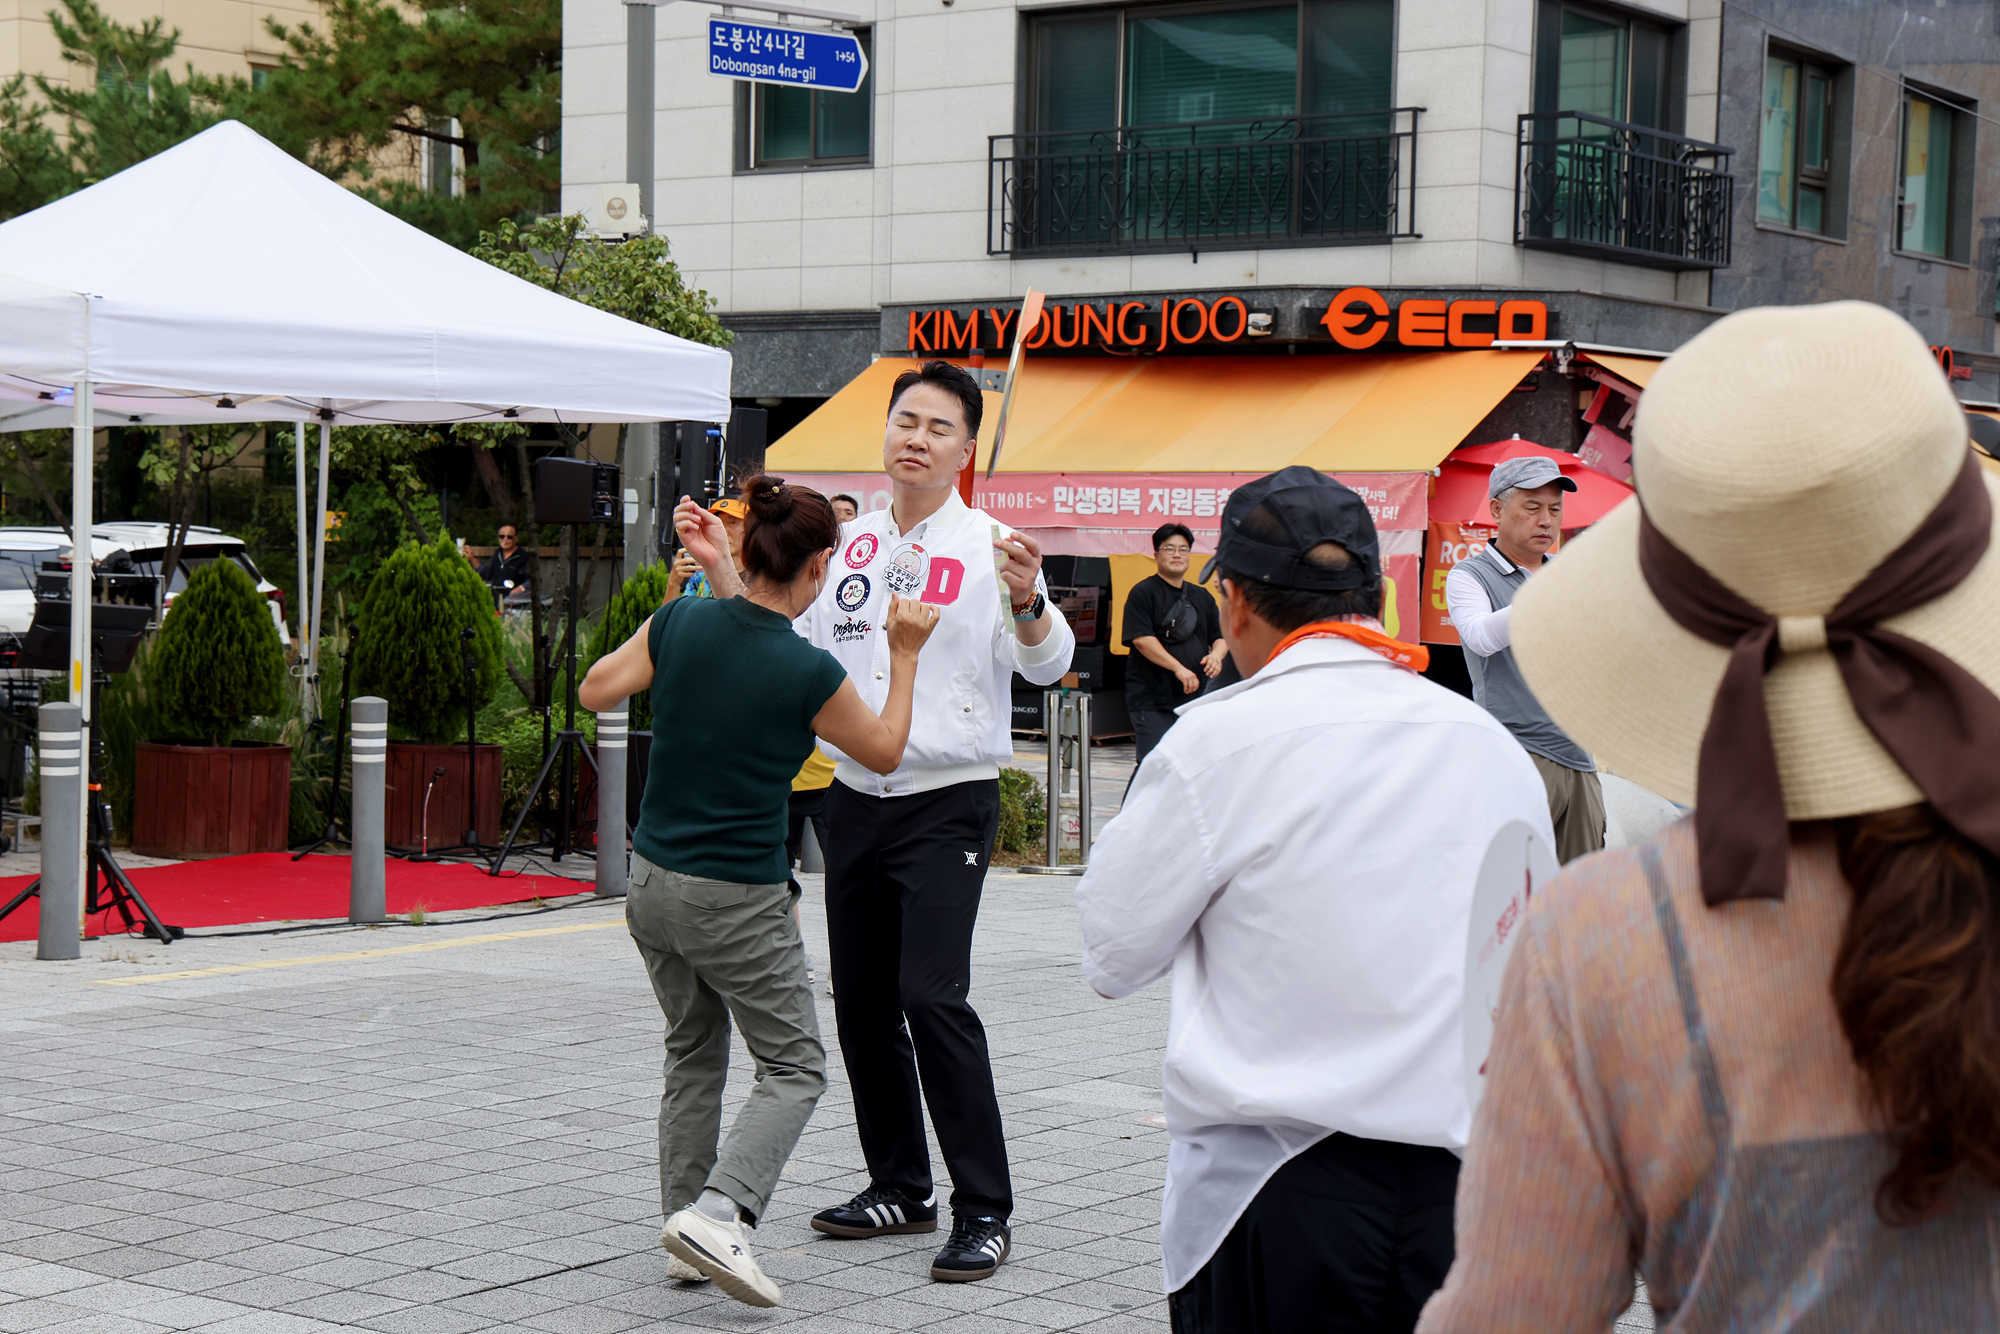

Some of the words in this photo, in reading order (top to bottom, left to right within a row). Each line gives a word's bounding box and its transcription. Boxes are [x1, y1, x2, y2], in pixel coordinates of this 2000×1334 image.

[713, 27, 806, 60] 도봉산4나길
[713, 55, 776, 77] Dobongsan
[777, 63, 816, 83] 4na-gil
[908, 309, 979, 350] KIM
[1156, 296, 1247, 352] JOO
[1398, 298, 1547, 347] ECO
[1053, 486, 1142, 516] 민생회복
[1382, 505, 1400, 521] 더!
[921, 557, 965, 606] D
